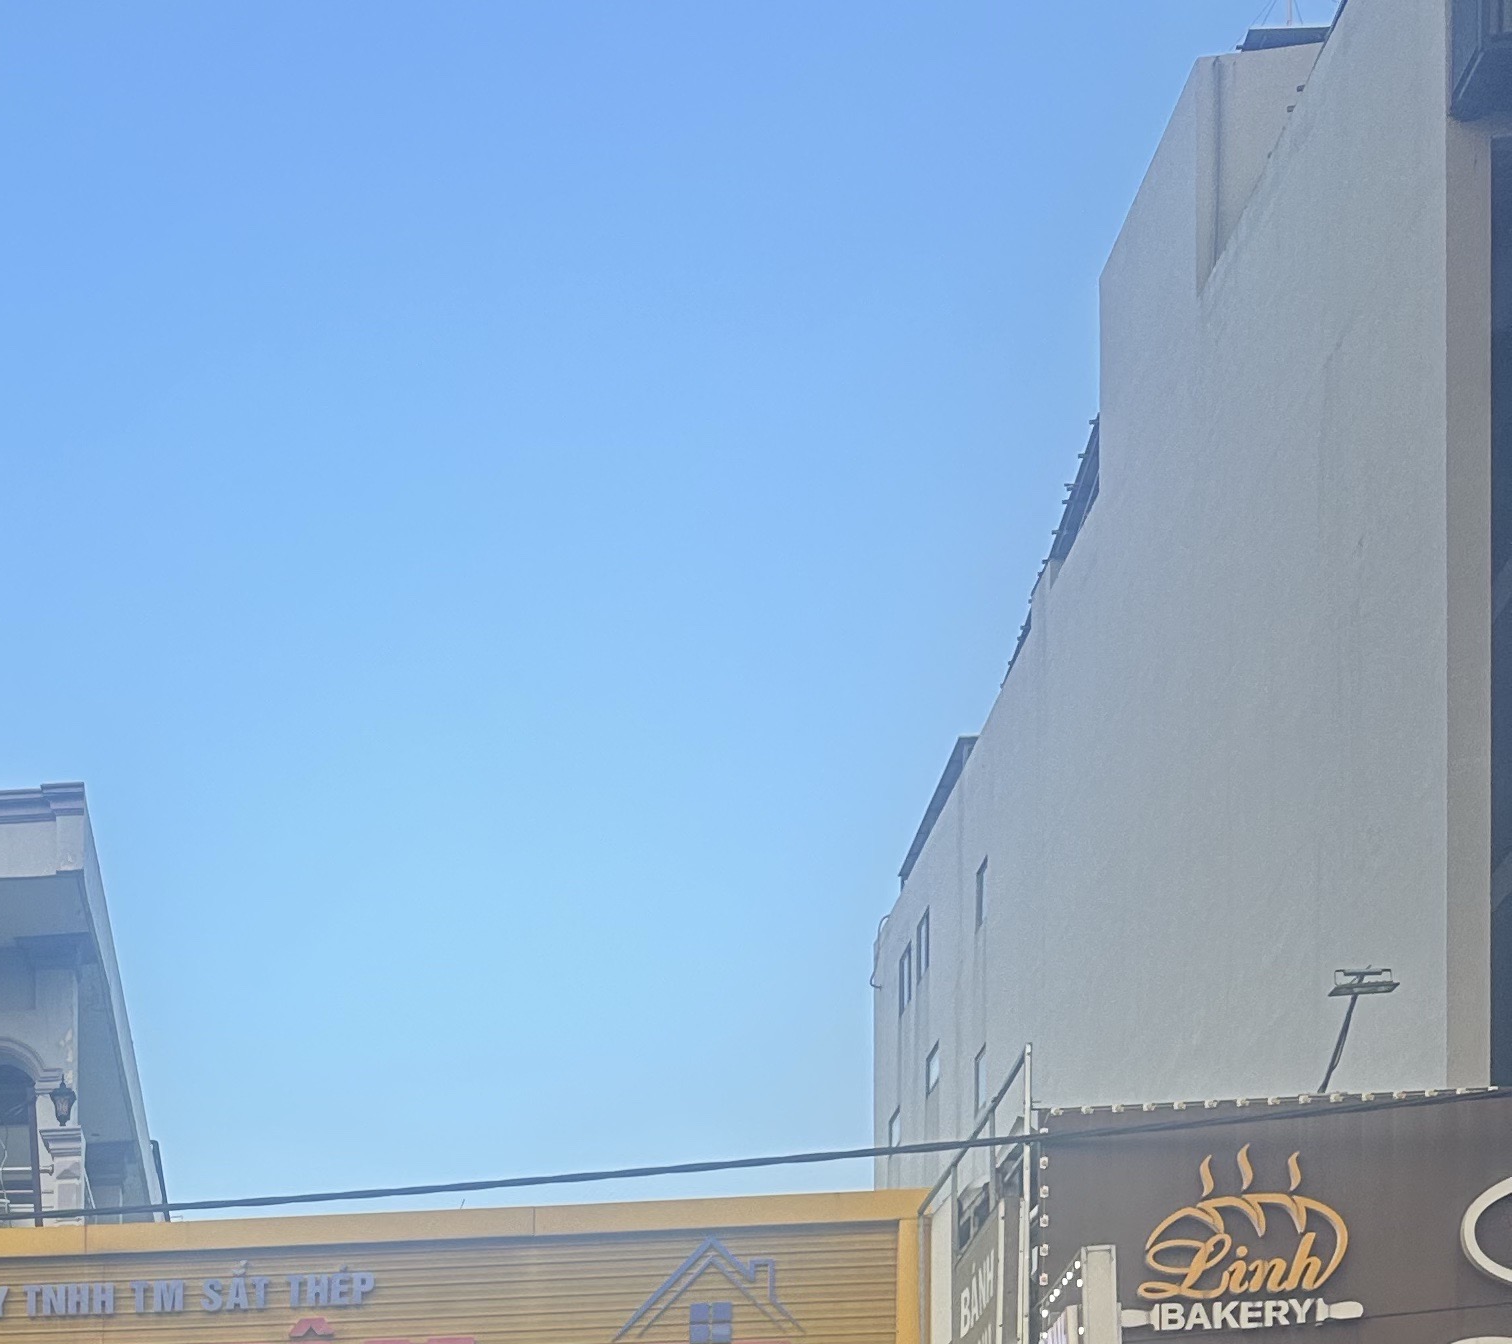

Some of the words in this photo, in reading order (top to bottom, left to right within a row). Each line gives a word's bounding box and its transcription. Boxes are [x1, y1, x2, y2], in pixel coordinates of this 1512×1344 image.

[24, 1282, 115, 1320] TNHH
[130, 1279, 186, 1314] TM
[201, 1260, 271, 1311] SẮT
[289, 1264, 376, 1308] THÉP
[960, 1249, 995, 1339] BÁNH
[1138, 1231, 1332, 1299] Linh
[1160, 1298, 1316, 1331] BAKERY
